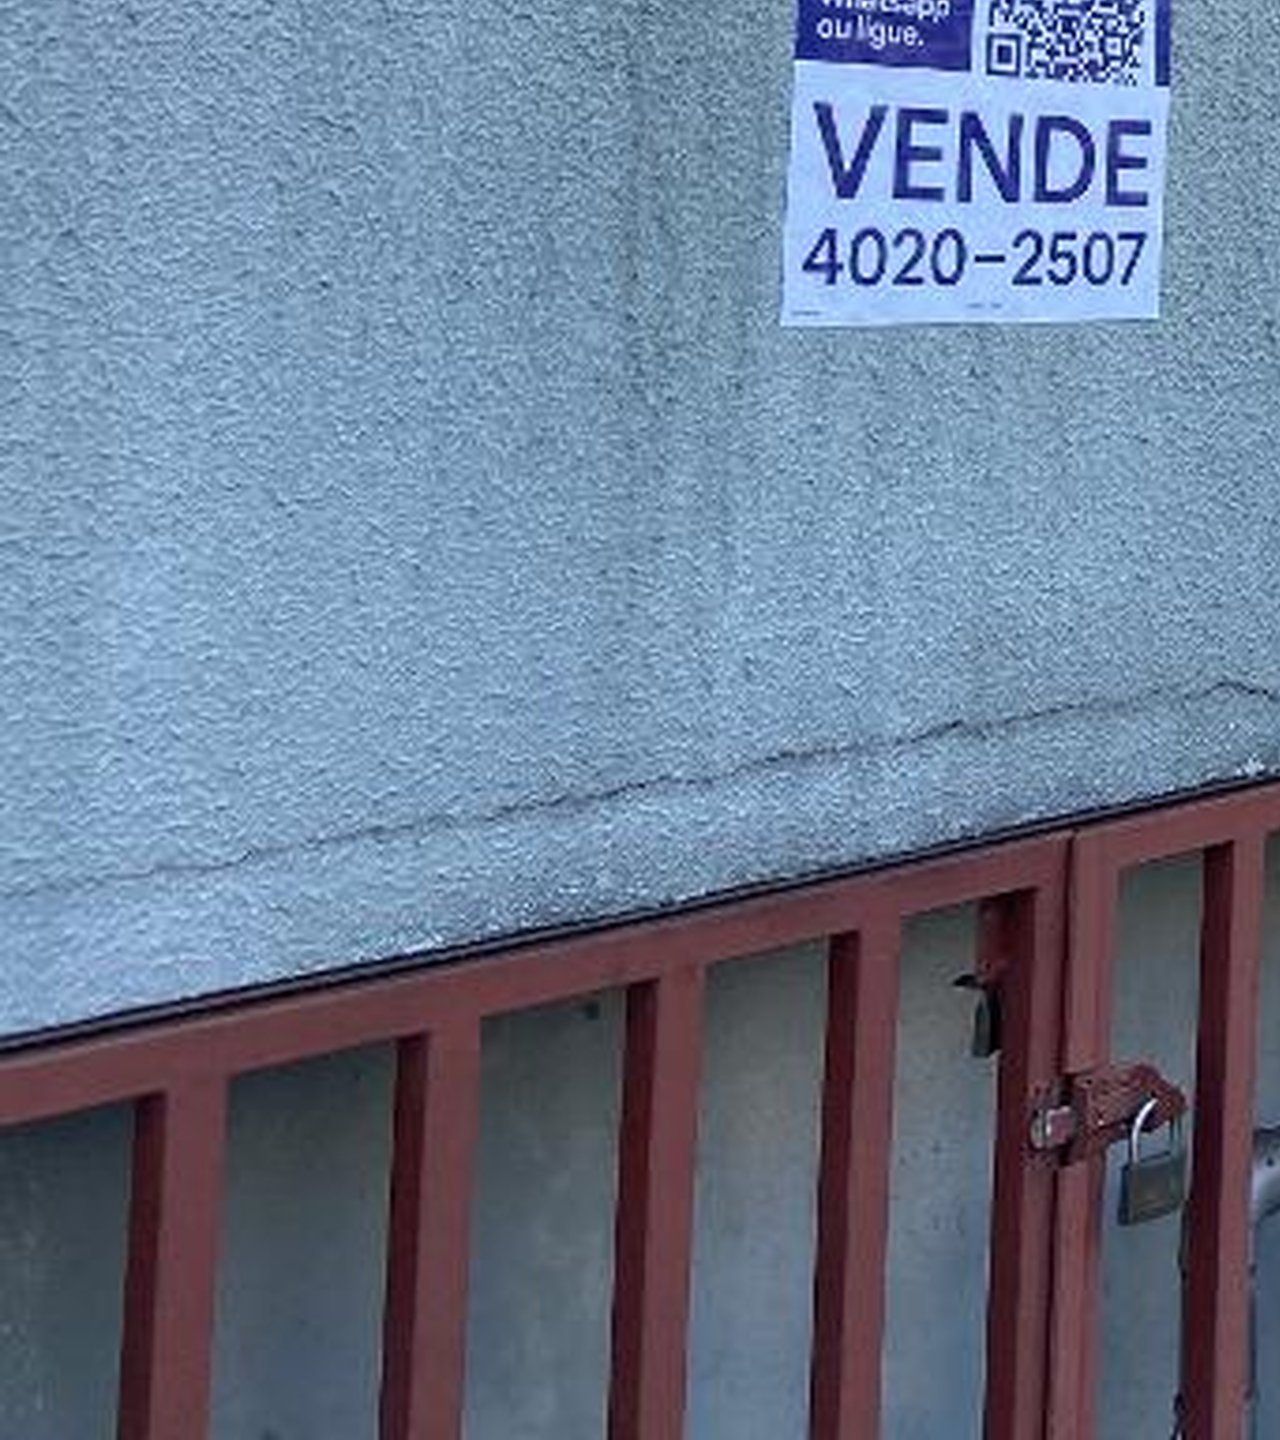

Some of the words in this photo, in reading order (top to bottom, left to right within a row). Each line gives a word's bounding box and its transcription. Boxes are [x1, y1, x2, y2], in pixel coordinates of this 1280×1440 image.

[816, 17, 852, 40] ou
[856, 14, 925, 50] ligue.
[813, 101, 1152, 208] VENDE
[802, 227, 1148, 288] 4020-2507
